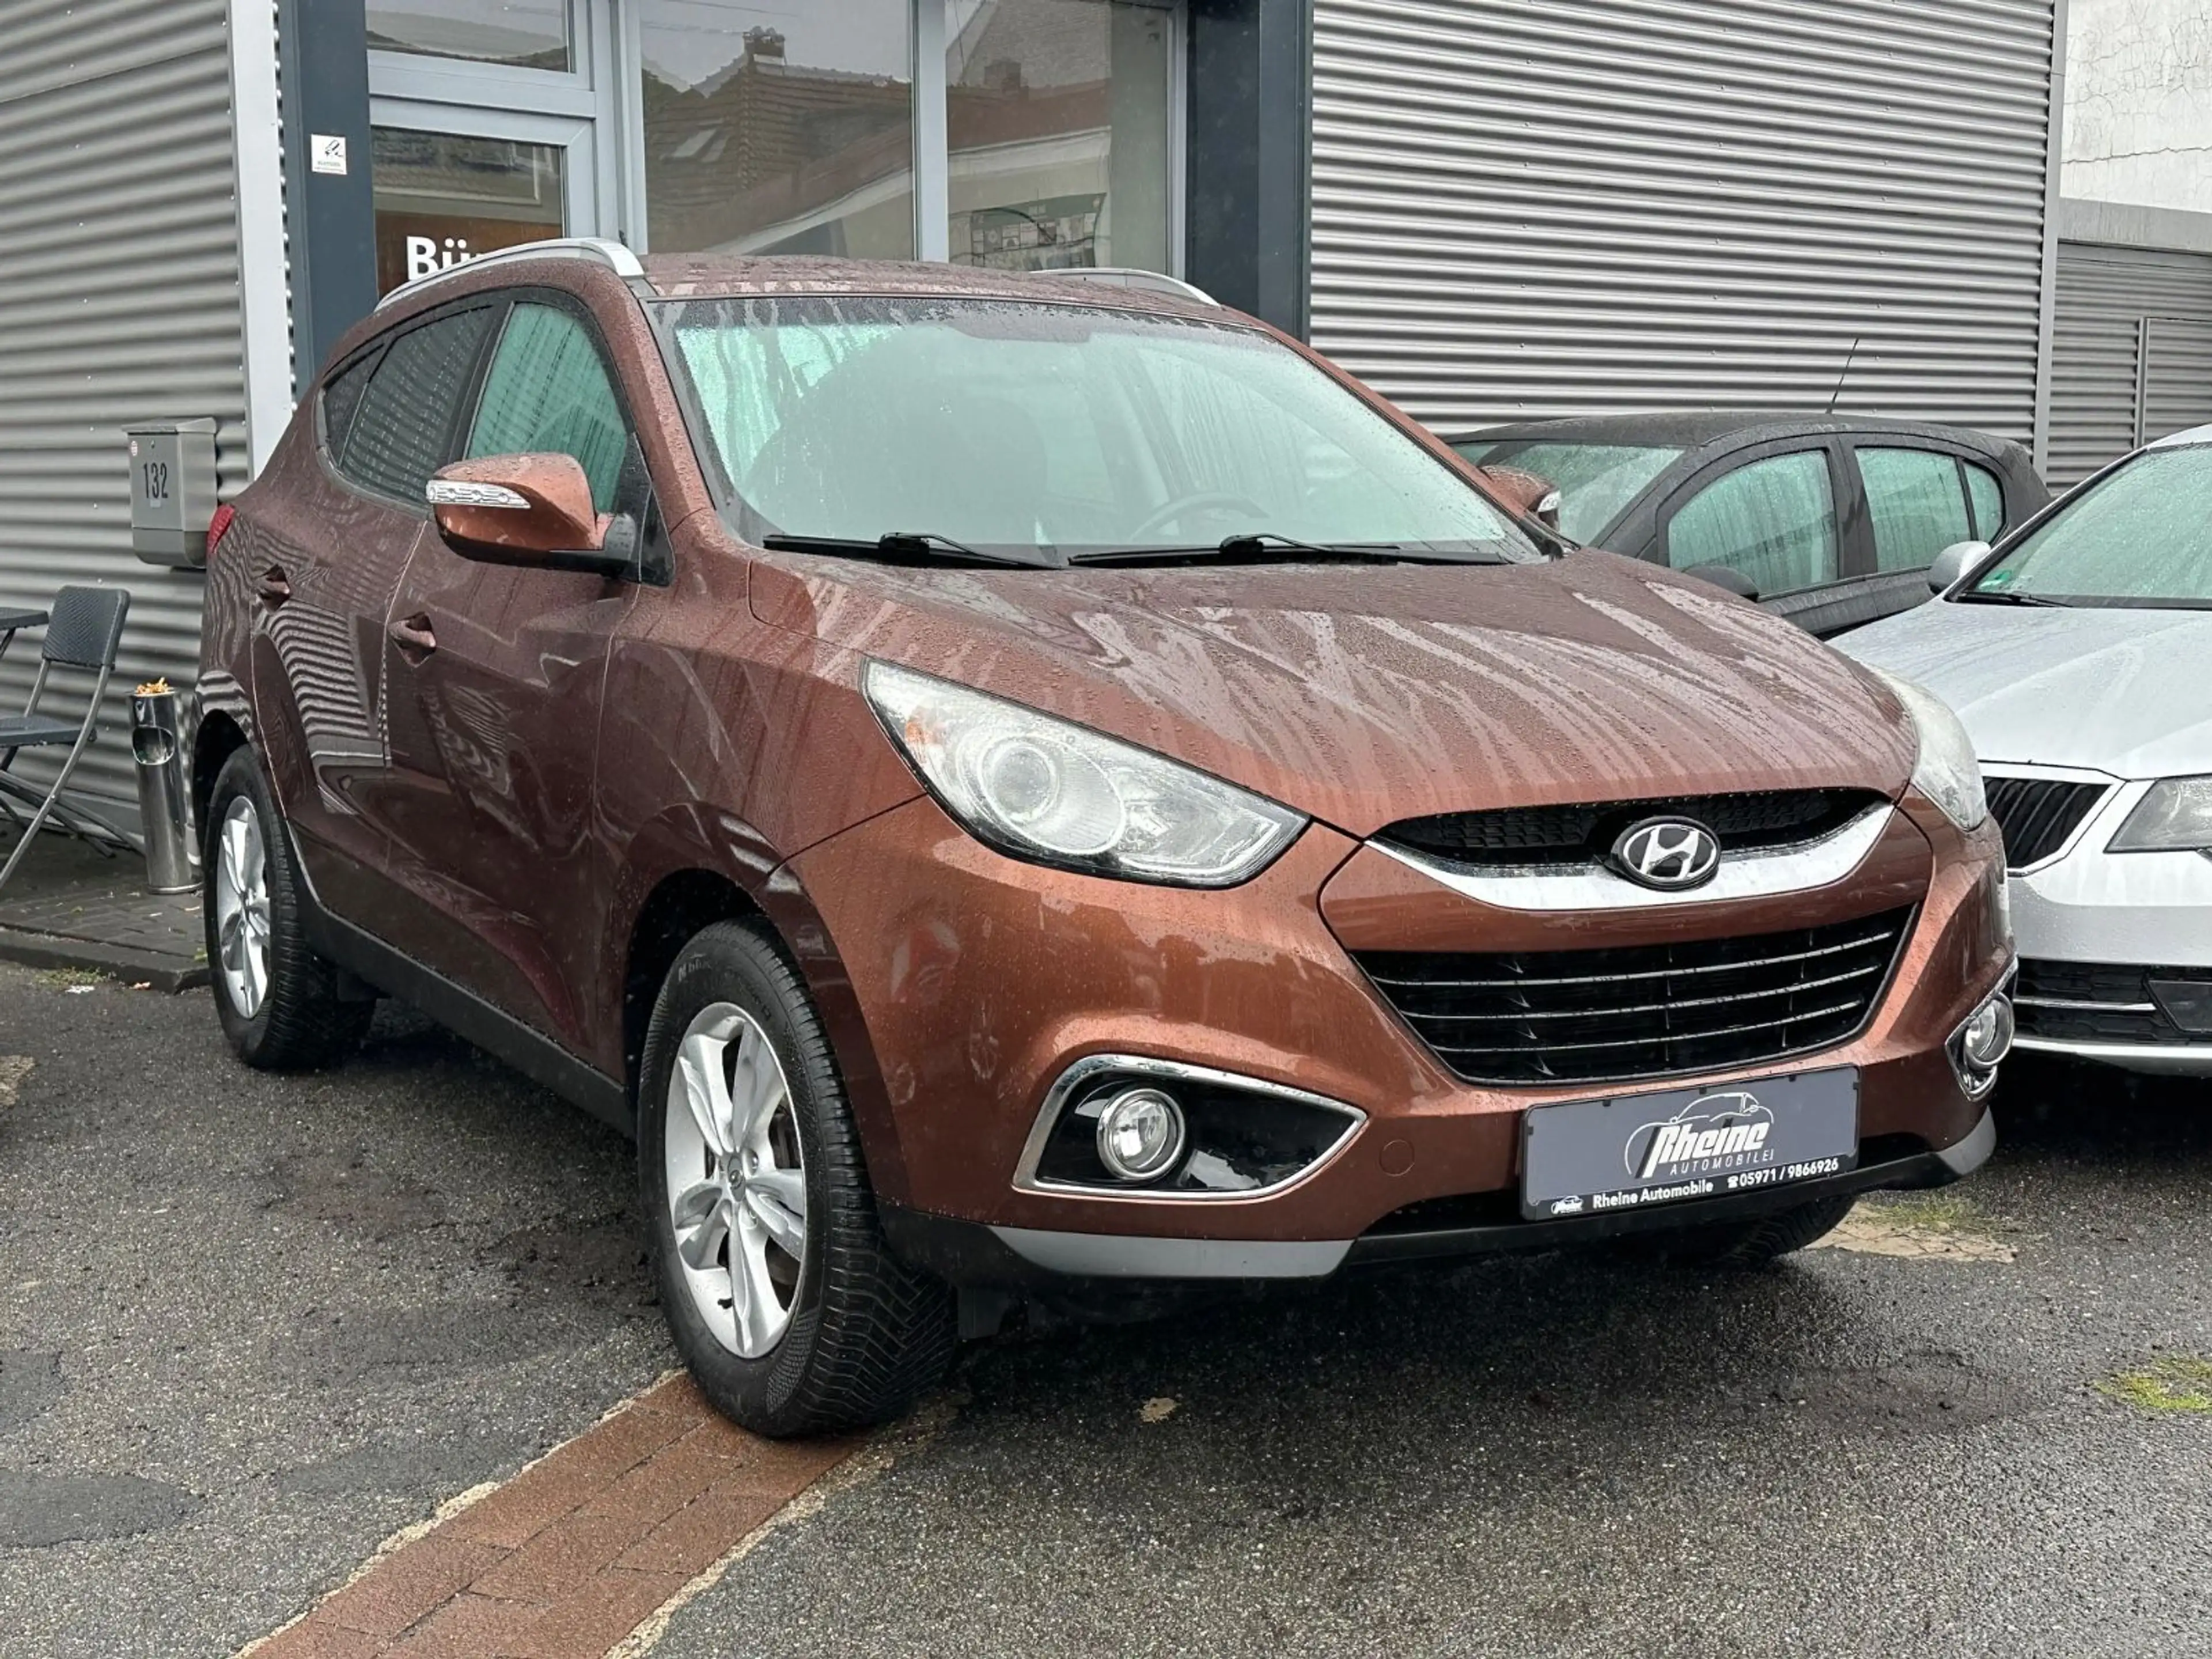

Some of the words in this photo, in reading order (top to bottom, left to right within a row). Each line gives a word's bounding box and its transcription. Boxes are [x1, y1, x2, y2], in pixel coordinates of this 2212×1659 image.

[407, 236, 484, 280] Bü
[142, 462, 168, 499] 132
[1636, 1119, 1770, 1179] Rheine
[1593, 1191, 1638, 1209] Rheine
[1640, 1179, 1714, 1202] Automobile
[1740, 1168, 1776, 1187] 05971
[1787, 1158, 1839, 1179] 9866926
